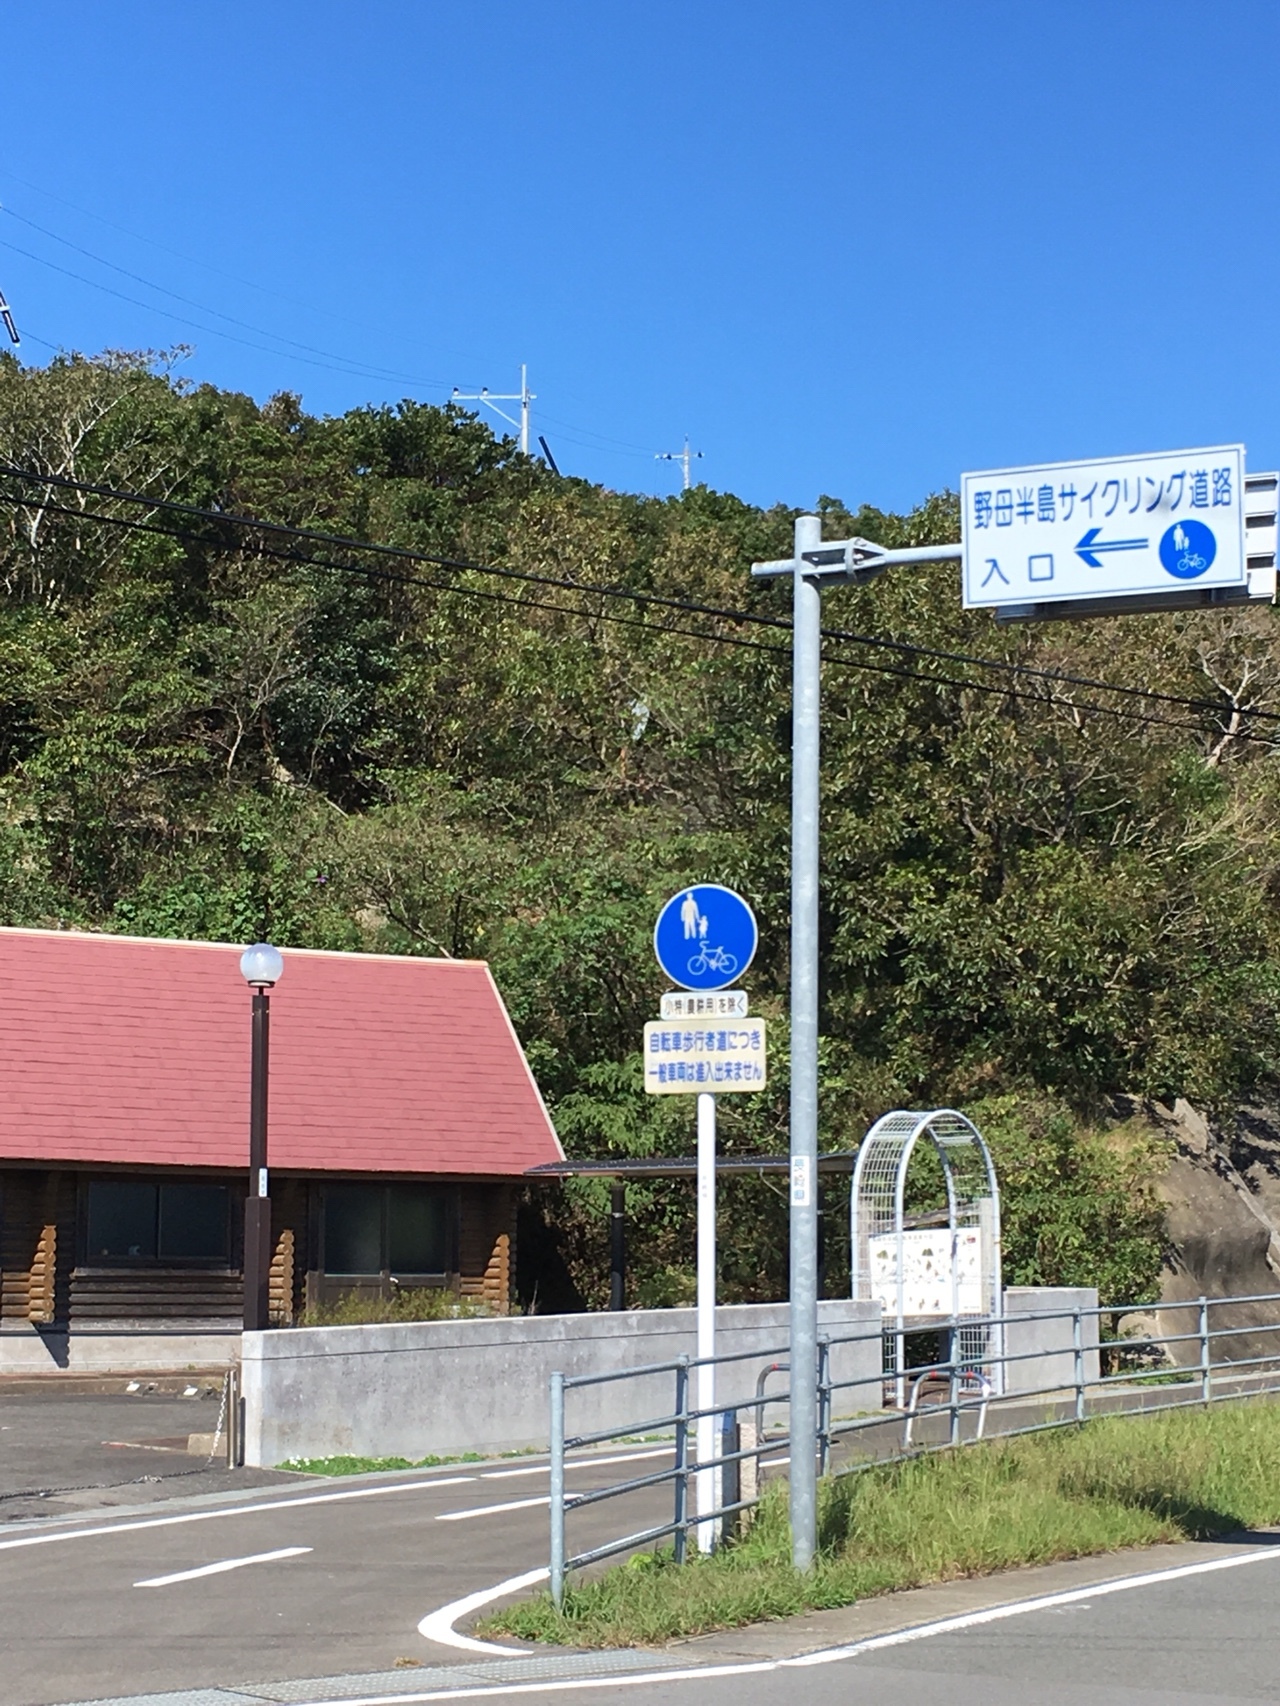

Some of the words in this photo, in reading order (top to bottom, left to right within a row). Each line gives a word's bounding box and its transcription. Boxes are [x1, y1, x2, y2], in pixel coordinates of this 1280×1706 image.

[974, 467, 1232, 529] 野母半島サイクリング道路
[981, 553, 1054, 587] 入口
[649, 1030, 761, 1053] 自転車歩行者道につき
[648, 1060, 762, 1084] 一般車両は進入出来ません
